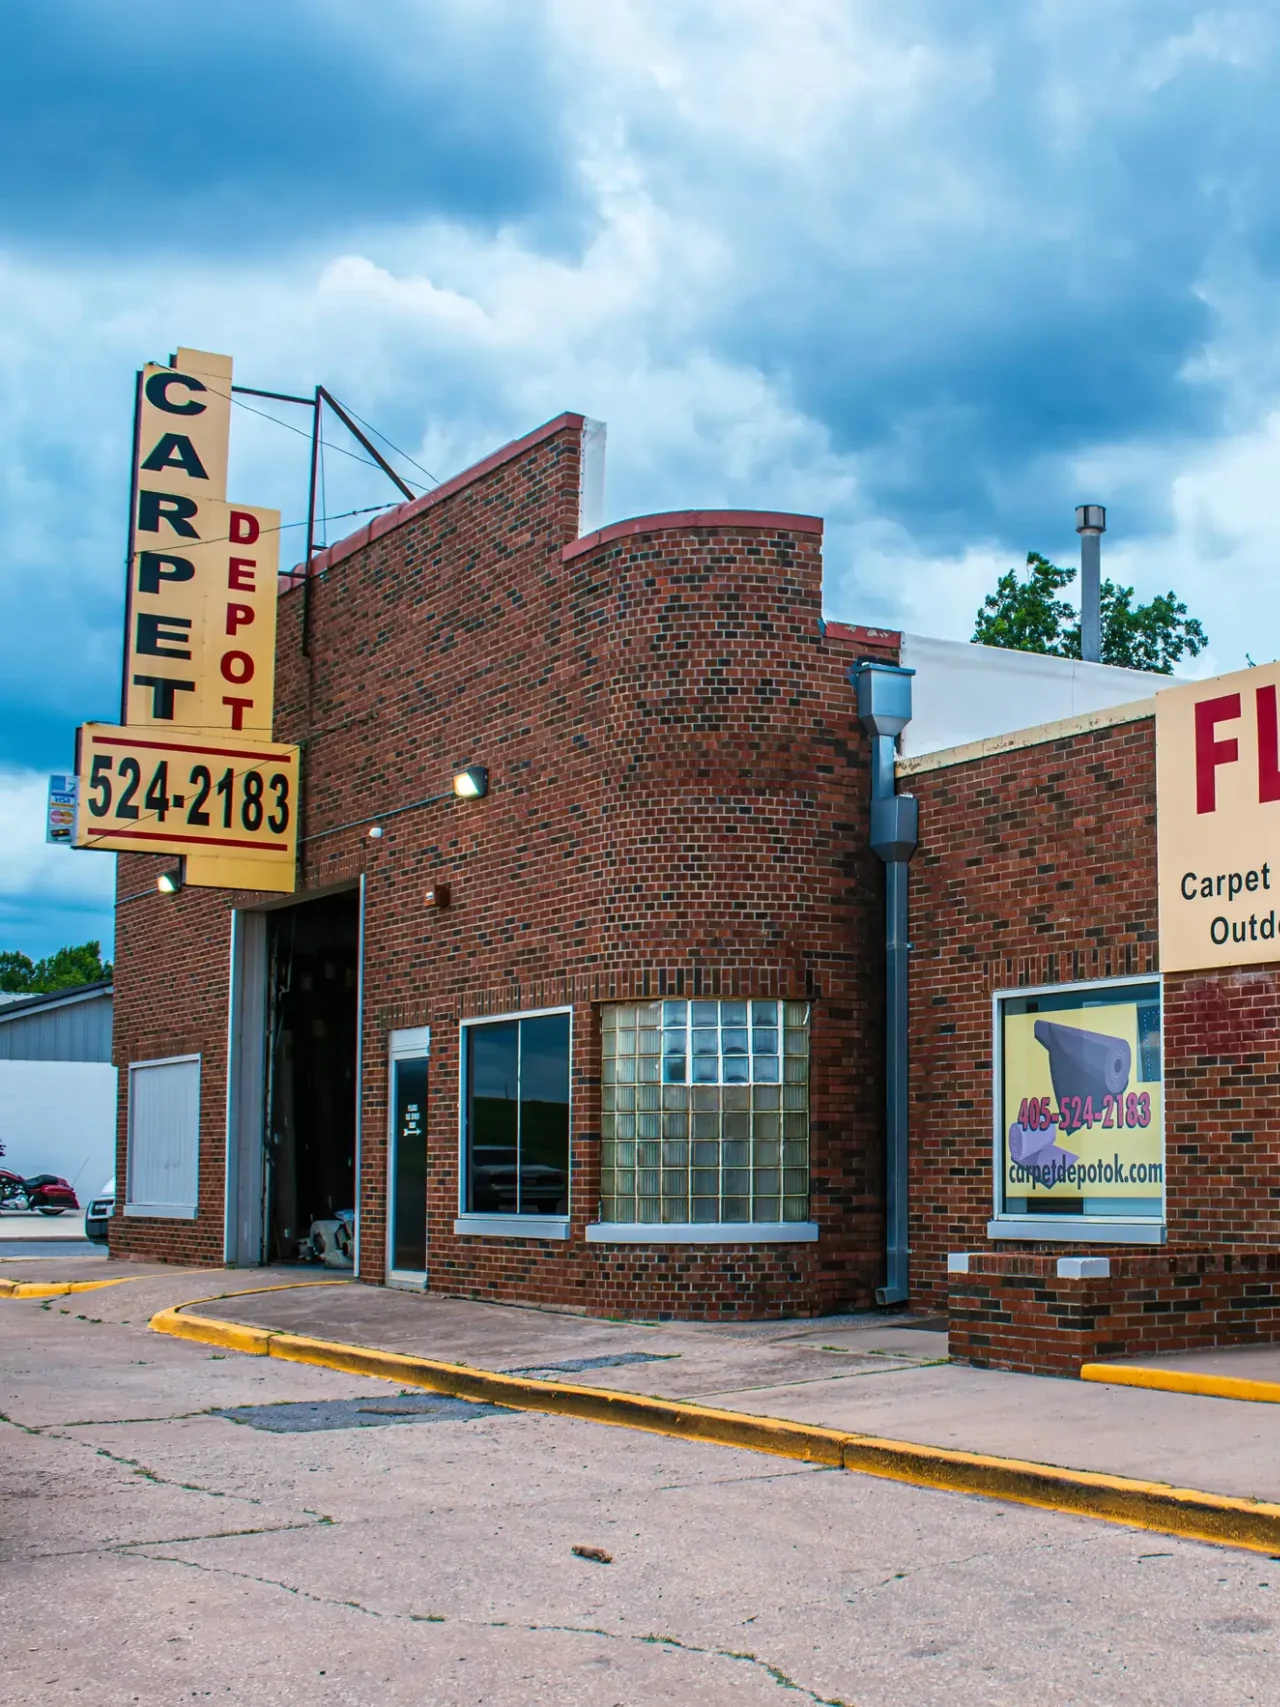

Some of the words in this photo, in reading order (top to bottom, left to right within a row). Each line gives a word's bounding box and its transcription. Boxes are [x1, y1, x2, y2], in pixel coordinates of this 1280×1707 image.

[132, 372, 210, 721] CARPET
[219, 510, 260, 732] DEPOT
[87, 753, 290, 836] 524-2183
[1180, 862, 1271, 902] Carpet
[1017, 1091, 1152, 1132] 405-524-2183
[1008, 1152, 1163, 1190] carpetdepotok.com
